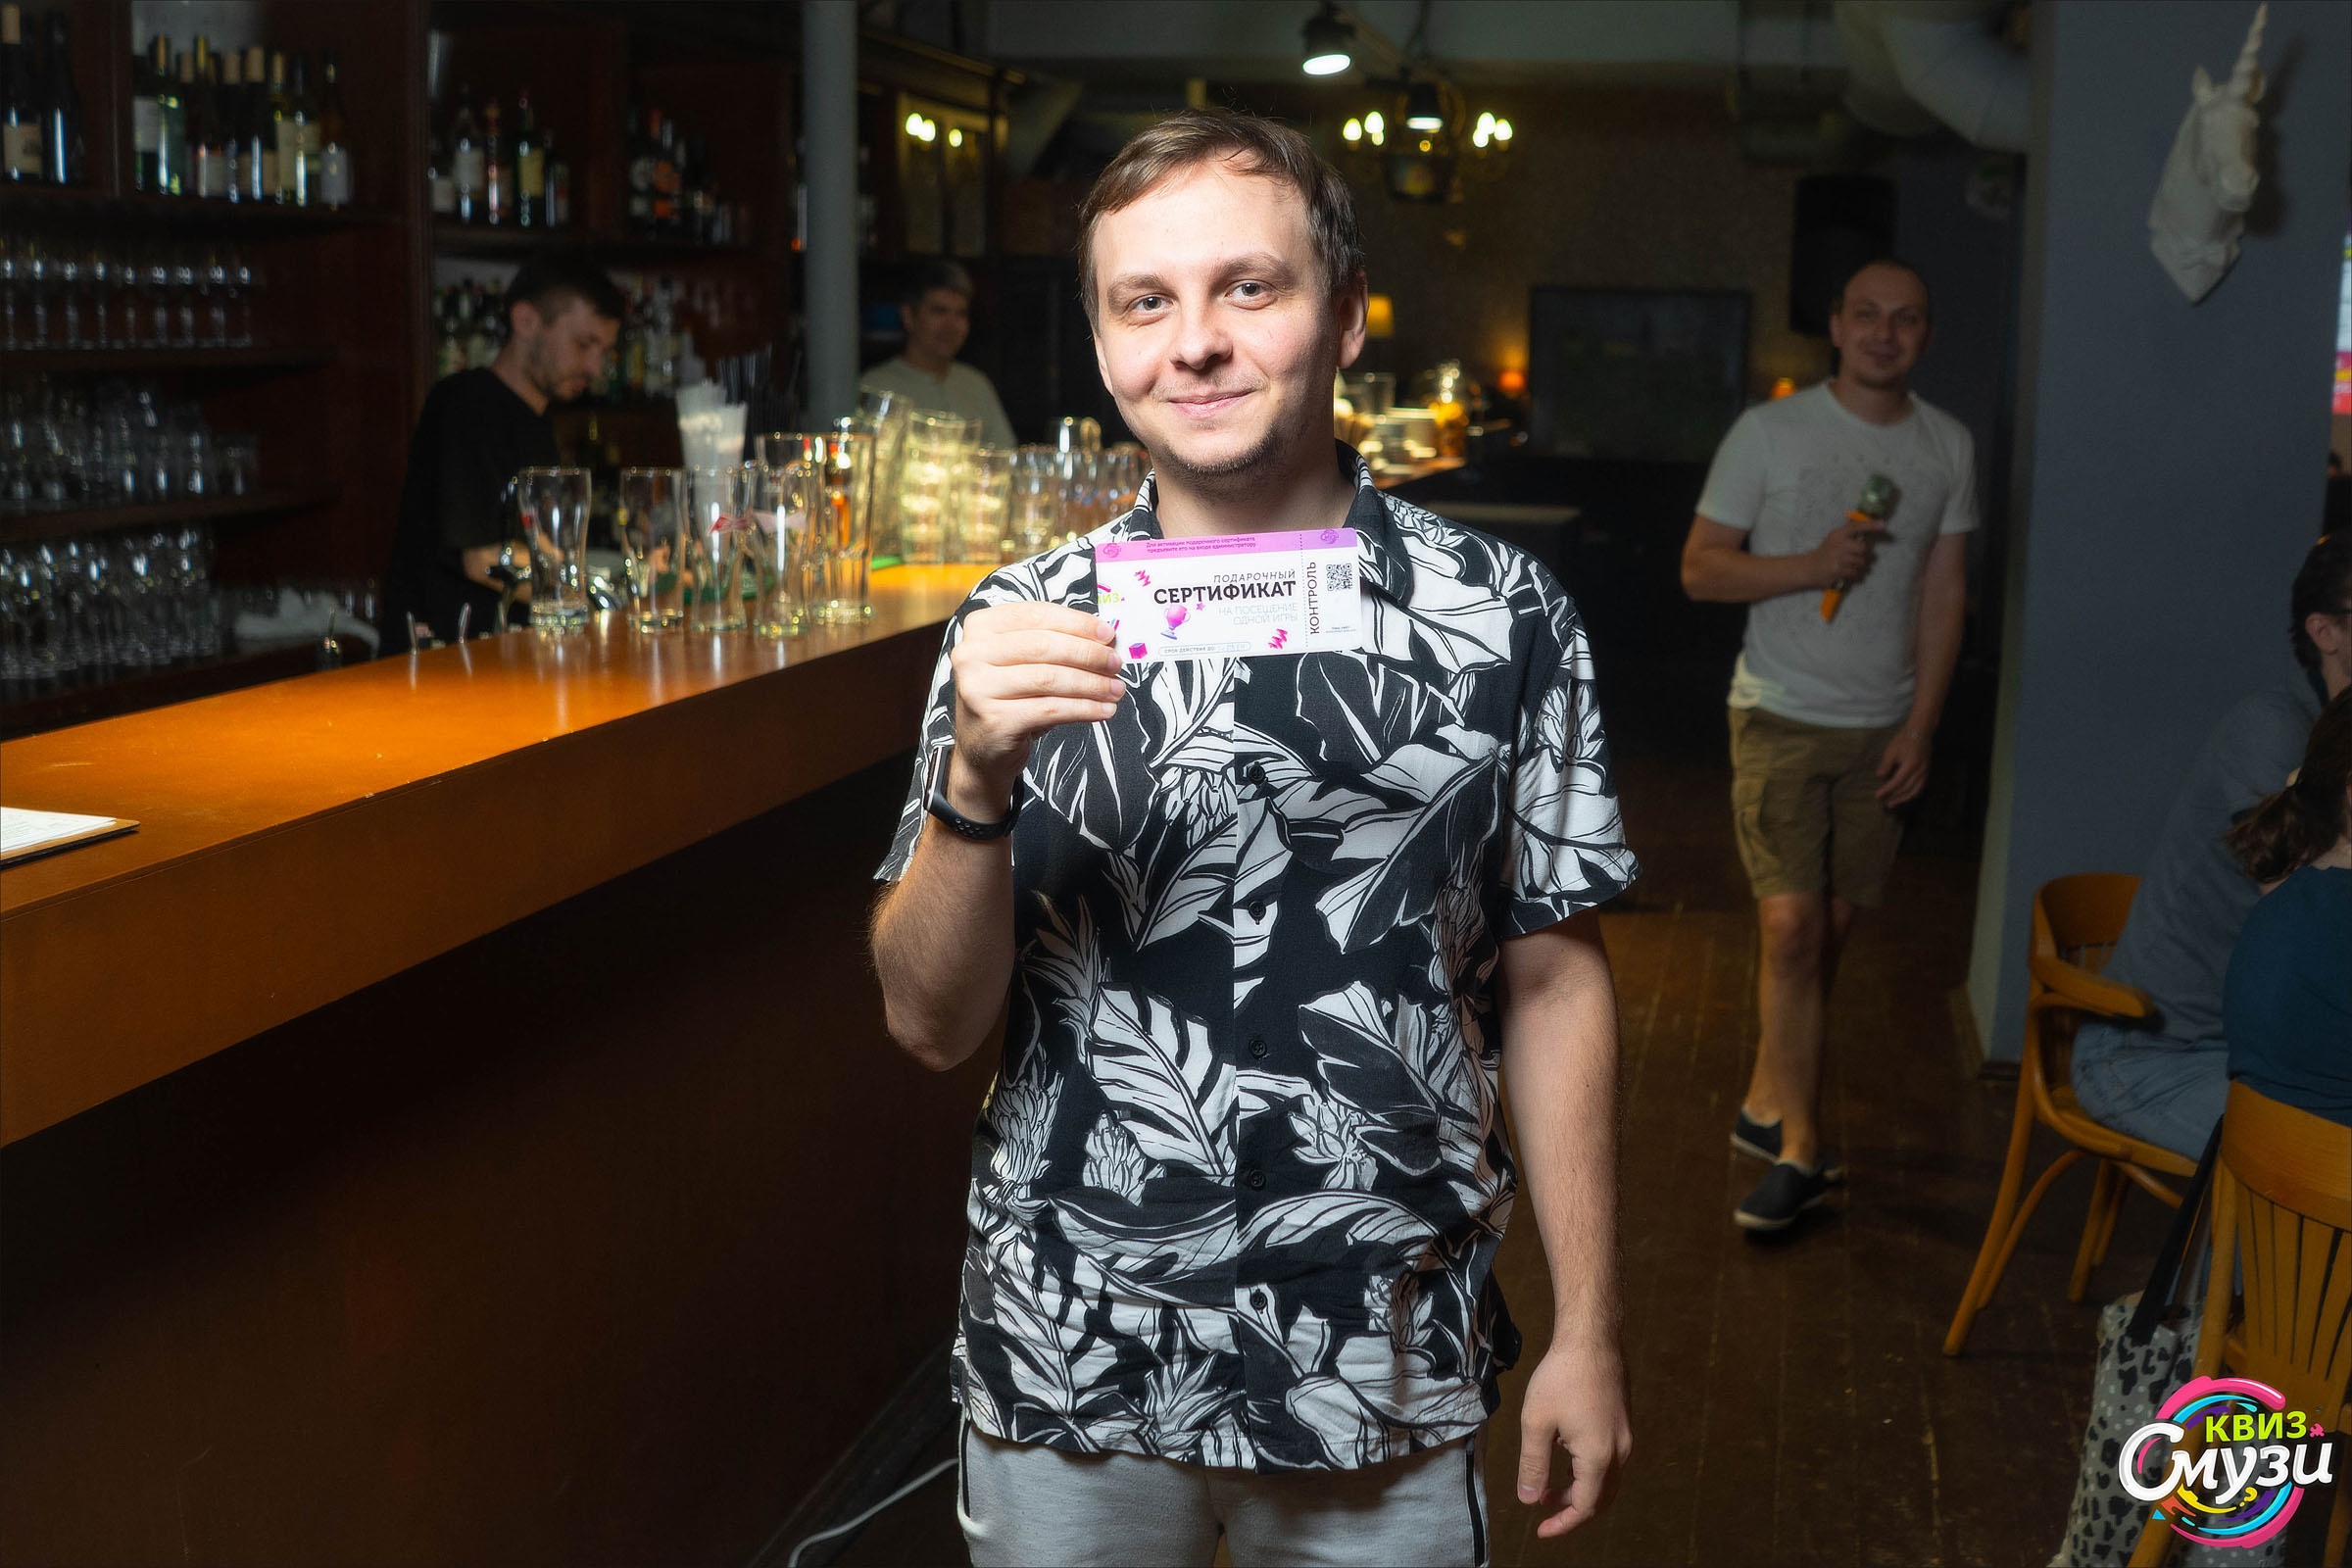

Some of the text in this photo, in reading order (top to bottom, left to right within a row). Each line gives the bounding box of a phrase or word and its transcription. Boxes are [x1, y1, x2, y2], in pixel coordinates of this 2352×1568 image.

[1213, 568, 1296, 583] ПОДАРОЧНЫЙ
[1153, 580, 1297, 605] СЕРТИФИКАТ
[1306, 562, 1320, 635] КОНТРОЛЬ
[1218, 603, 1298, 615] НА ПОСЕЩЕНИЕ
[1233, 612, 1298, 625] ОДНОЙ ИГРЫ
